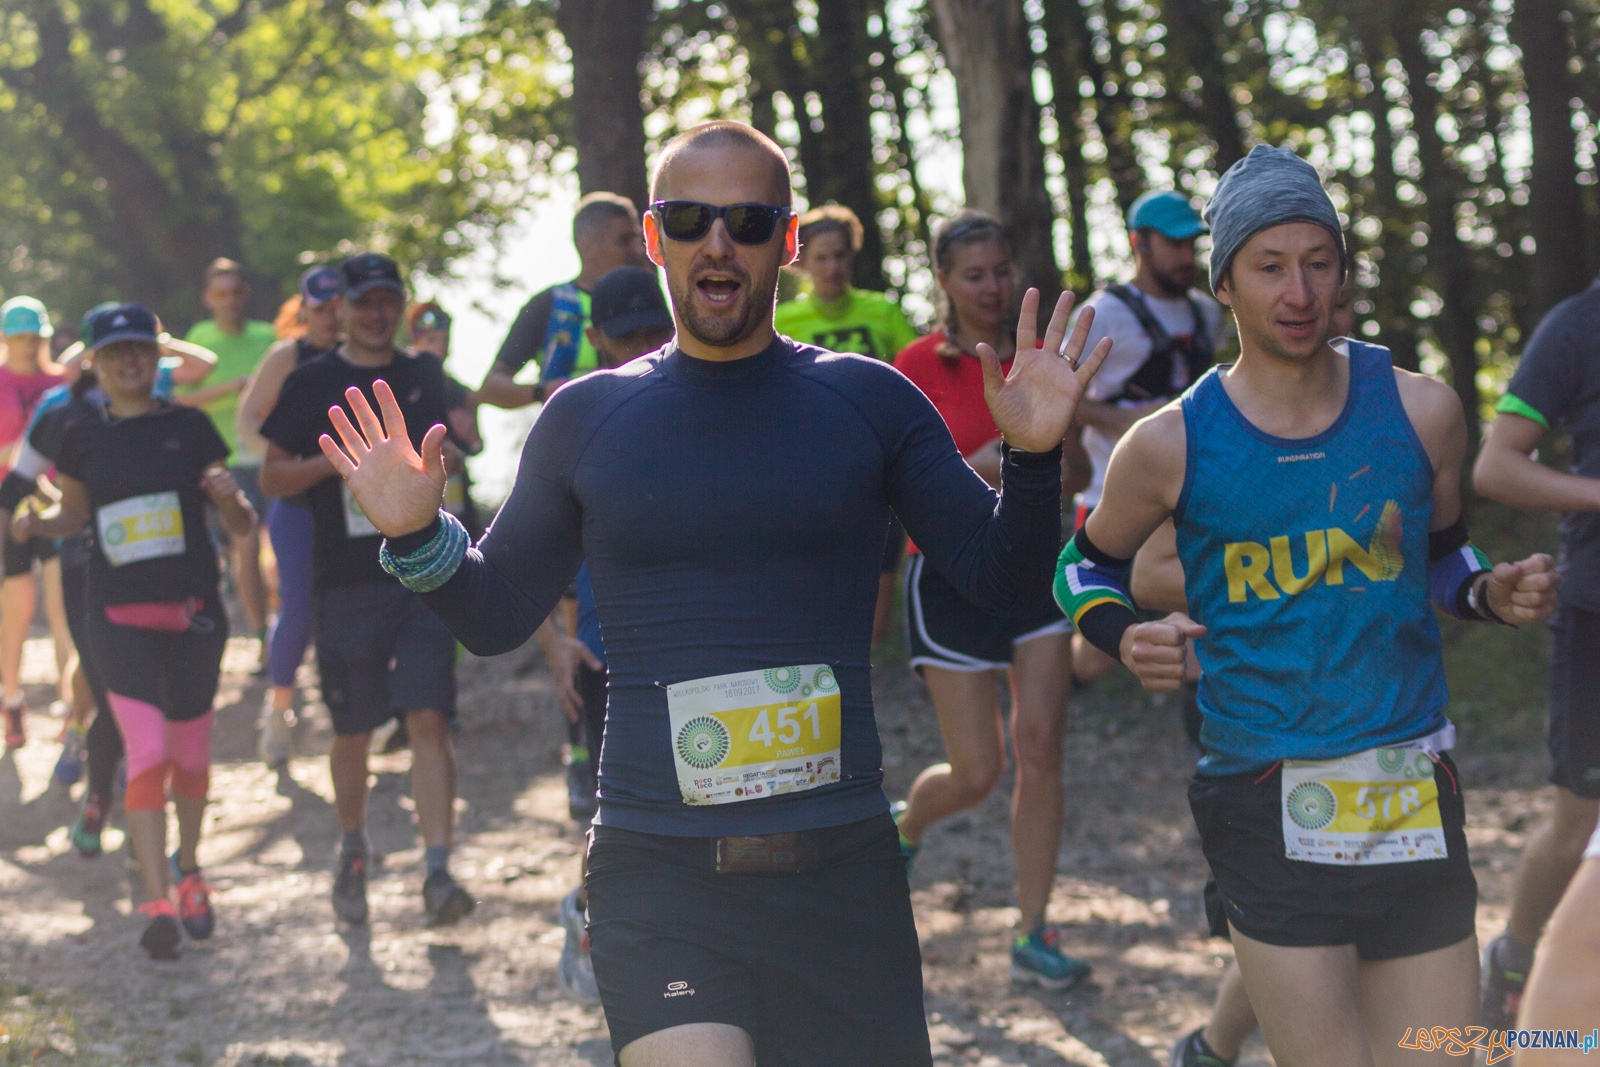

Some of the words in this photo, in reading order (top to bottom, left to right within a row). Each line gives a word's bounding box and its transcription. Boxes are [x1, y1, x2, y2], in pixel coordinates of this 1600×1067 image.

[1277, 451, 1326, 463] RUNSPIRATION
[1224, 498, 1405, 603] RUN
[713, 683, 727, 691] PARK
[730, 679, 759, 688] NARODOWY
[748, 702, 821, 747] 451
[776, 747, 805, 758] PAWEŁ
[1355, 785, 1422, 820] 578
[664, 989, 695, 998] Kalenji
